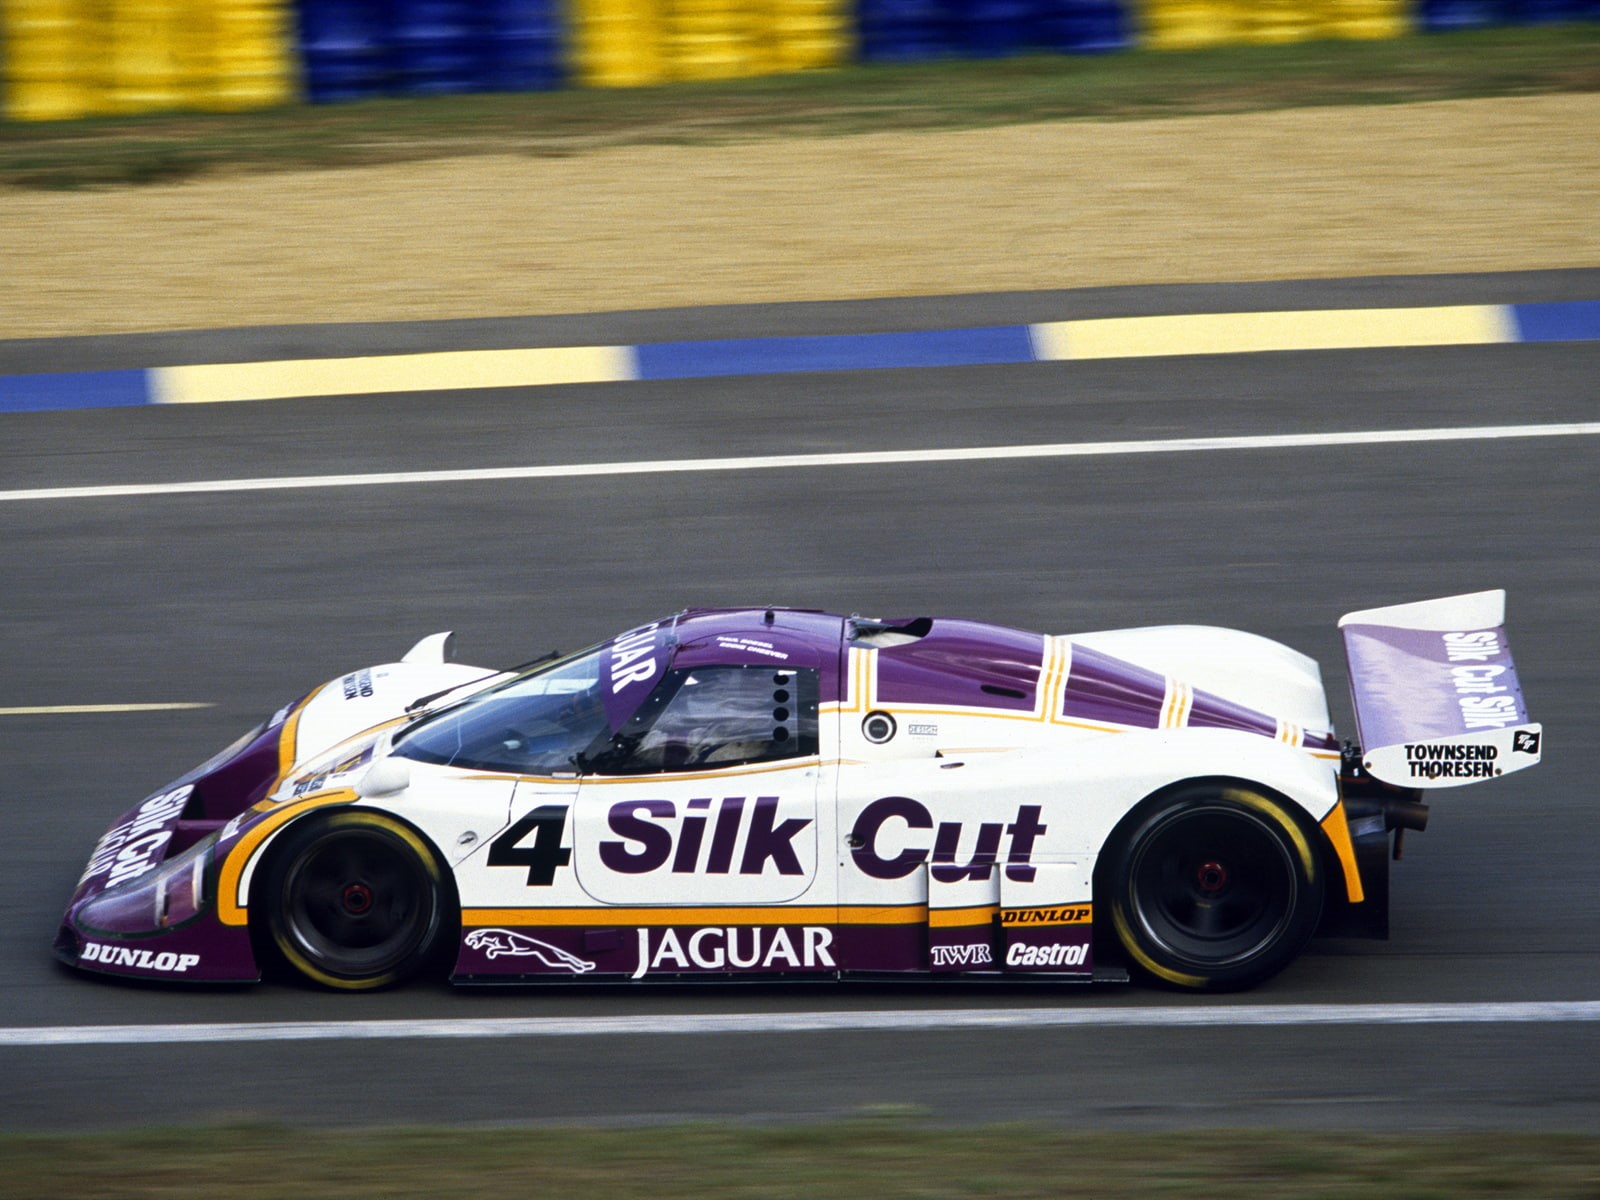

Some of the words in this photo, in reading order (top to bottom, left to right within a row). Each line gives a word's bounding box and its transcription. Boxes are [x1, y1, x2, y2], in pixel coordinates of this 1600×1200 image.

[611, 622, 659, 694] GUAR
[1442, 631, 1501, 661] Silk
[1451, 665, 1507, 694] Cut
[1459, 696, 1519, 728] Silk
[1404, 745, 1498, 760] TOWNSEND
[1408, 761, 1494, 778] THORESEN
[124, 784, 195, 842] Silk
[486, 805, 572, 886] 4
[599, 796, 814, 876] Silk
[850, 796, 1047, 883] Cut
[104, 831, 172, 889] Cut
[1002, 909, 1090, 923] DUNLOP
[81, 942, 200, 972] DUNLOP
[631, 927, 837, 978] JAGUAR
[931, 944, 993, 966] TWR
[1005, 943, 1090, 966] Castrol
